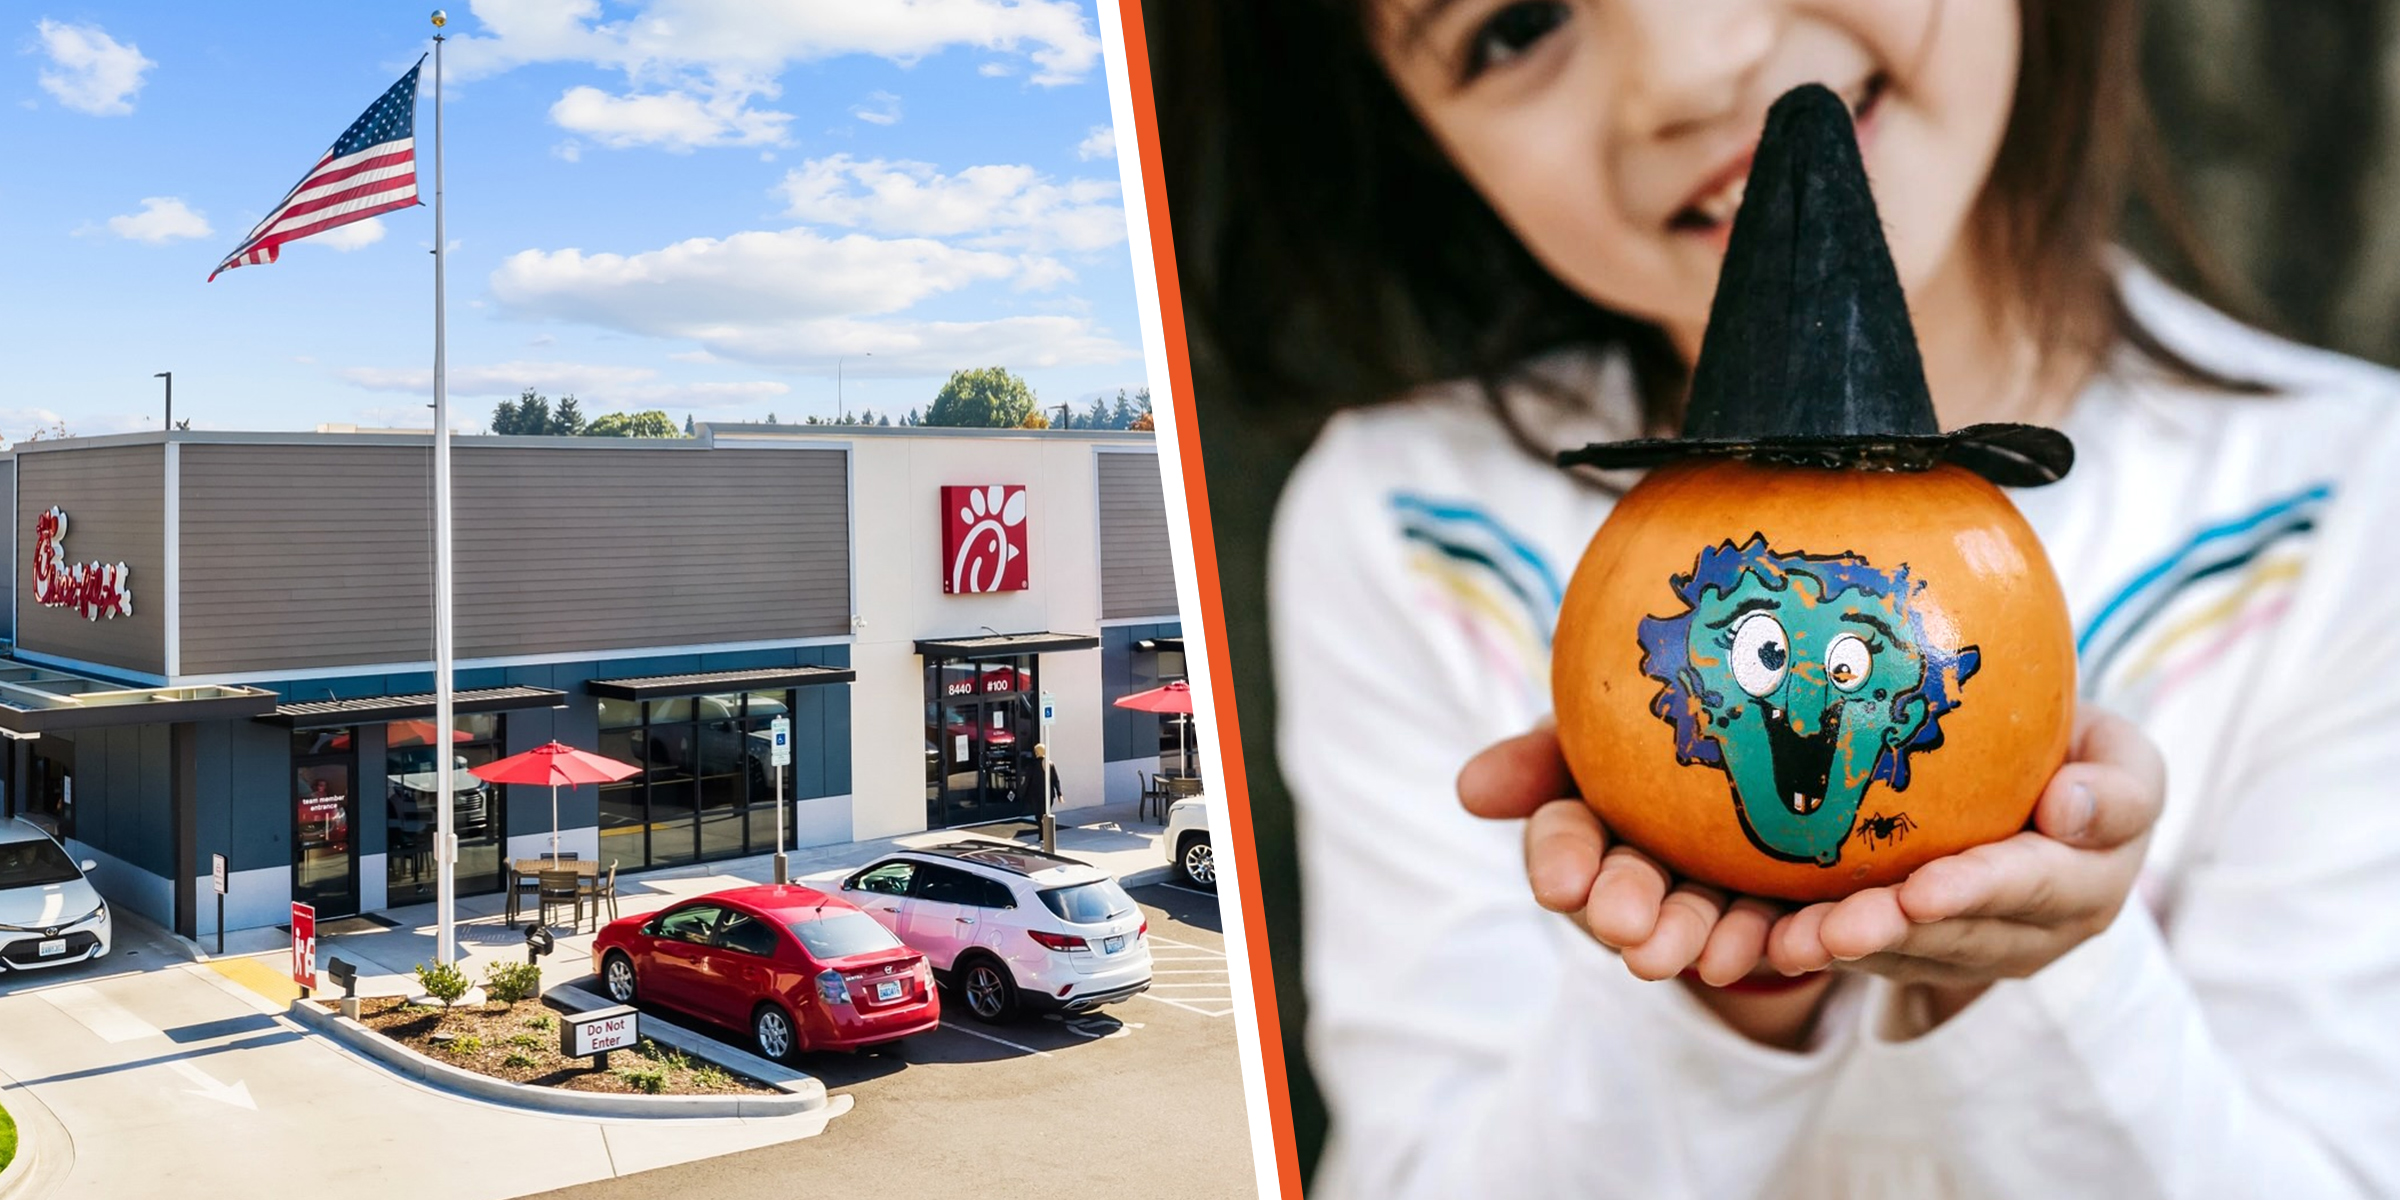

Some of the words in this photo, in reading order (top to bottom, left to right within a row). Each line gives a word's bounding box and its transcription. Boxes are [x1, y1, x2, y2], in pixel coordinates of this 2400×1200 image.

[33, 507, 128, 619] Chick-fil-A
[948, 683, 972, 695] 8440
[987, 680, 1008, 691] #100
[310, 803, 337, 811] entrance
[587, 1024, 603, 1036] Do
[605, 1019, 625, 1033] Not
[592, 1036, 621, 1050] Enter
